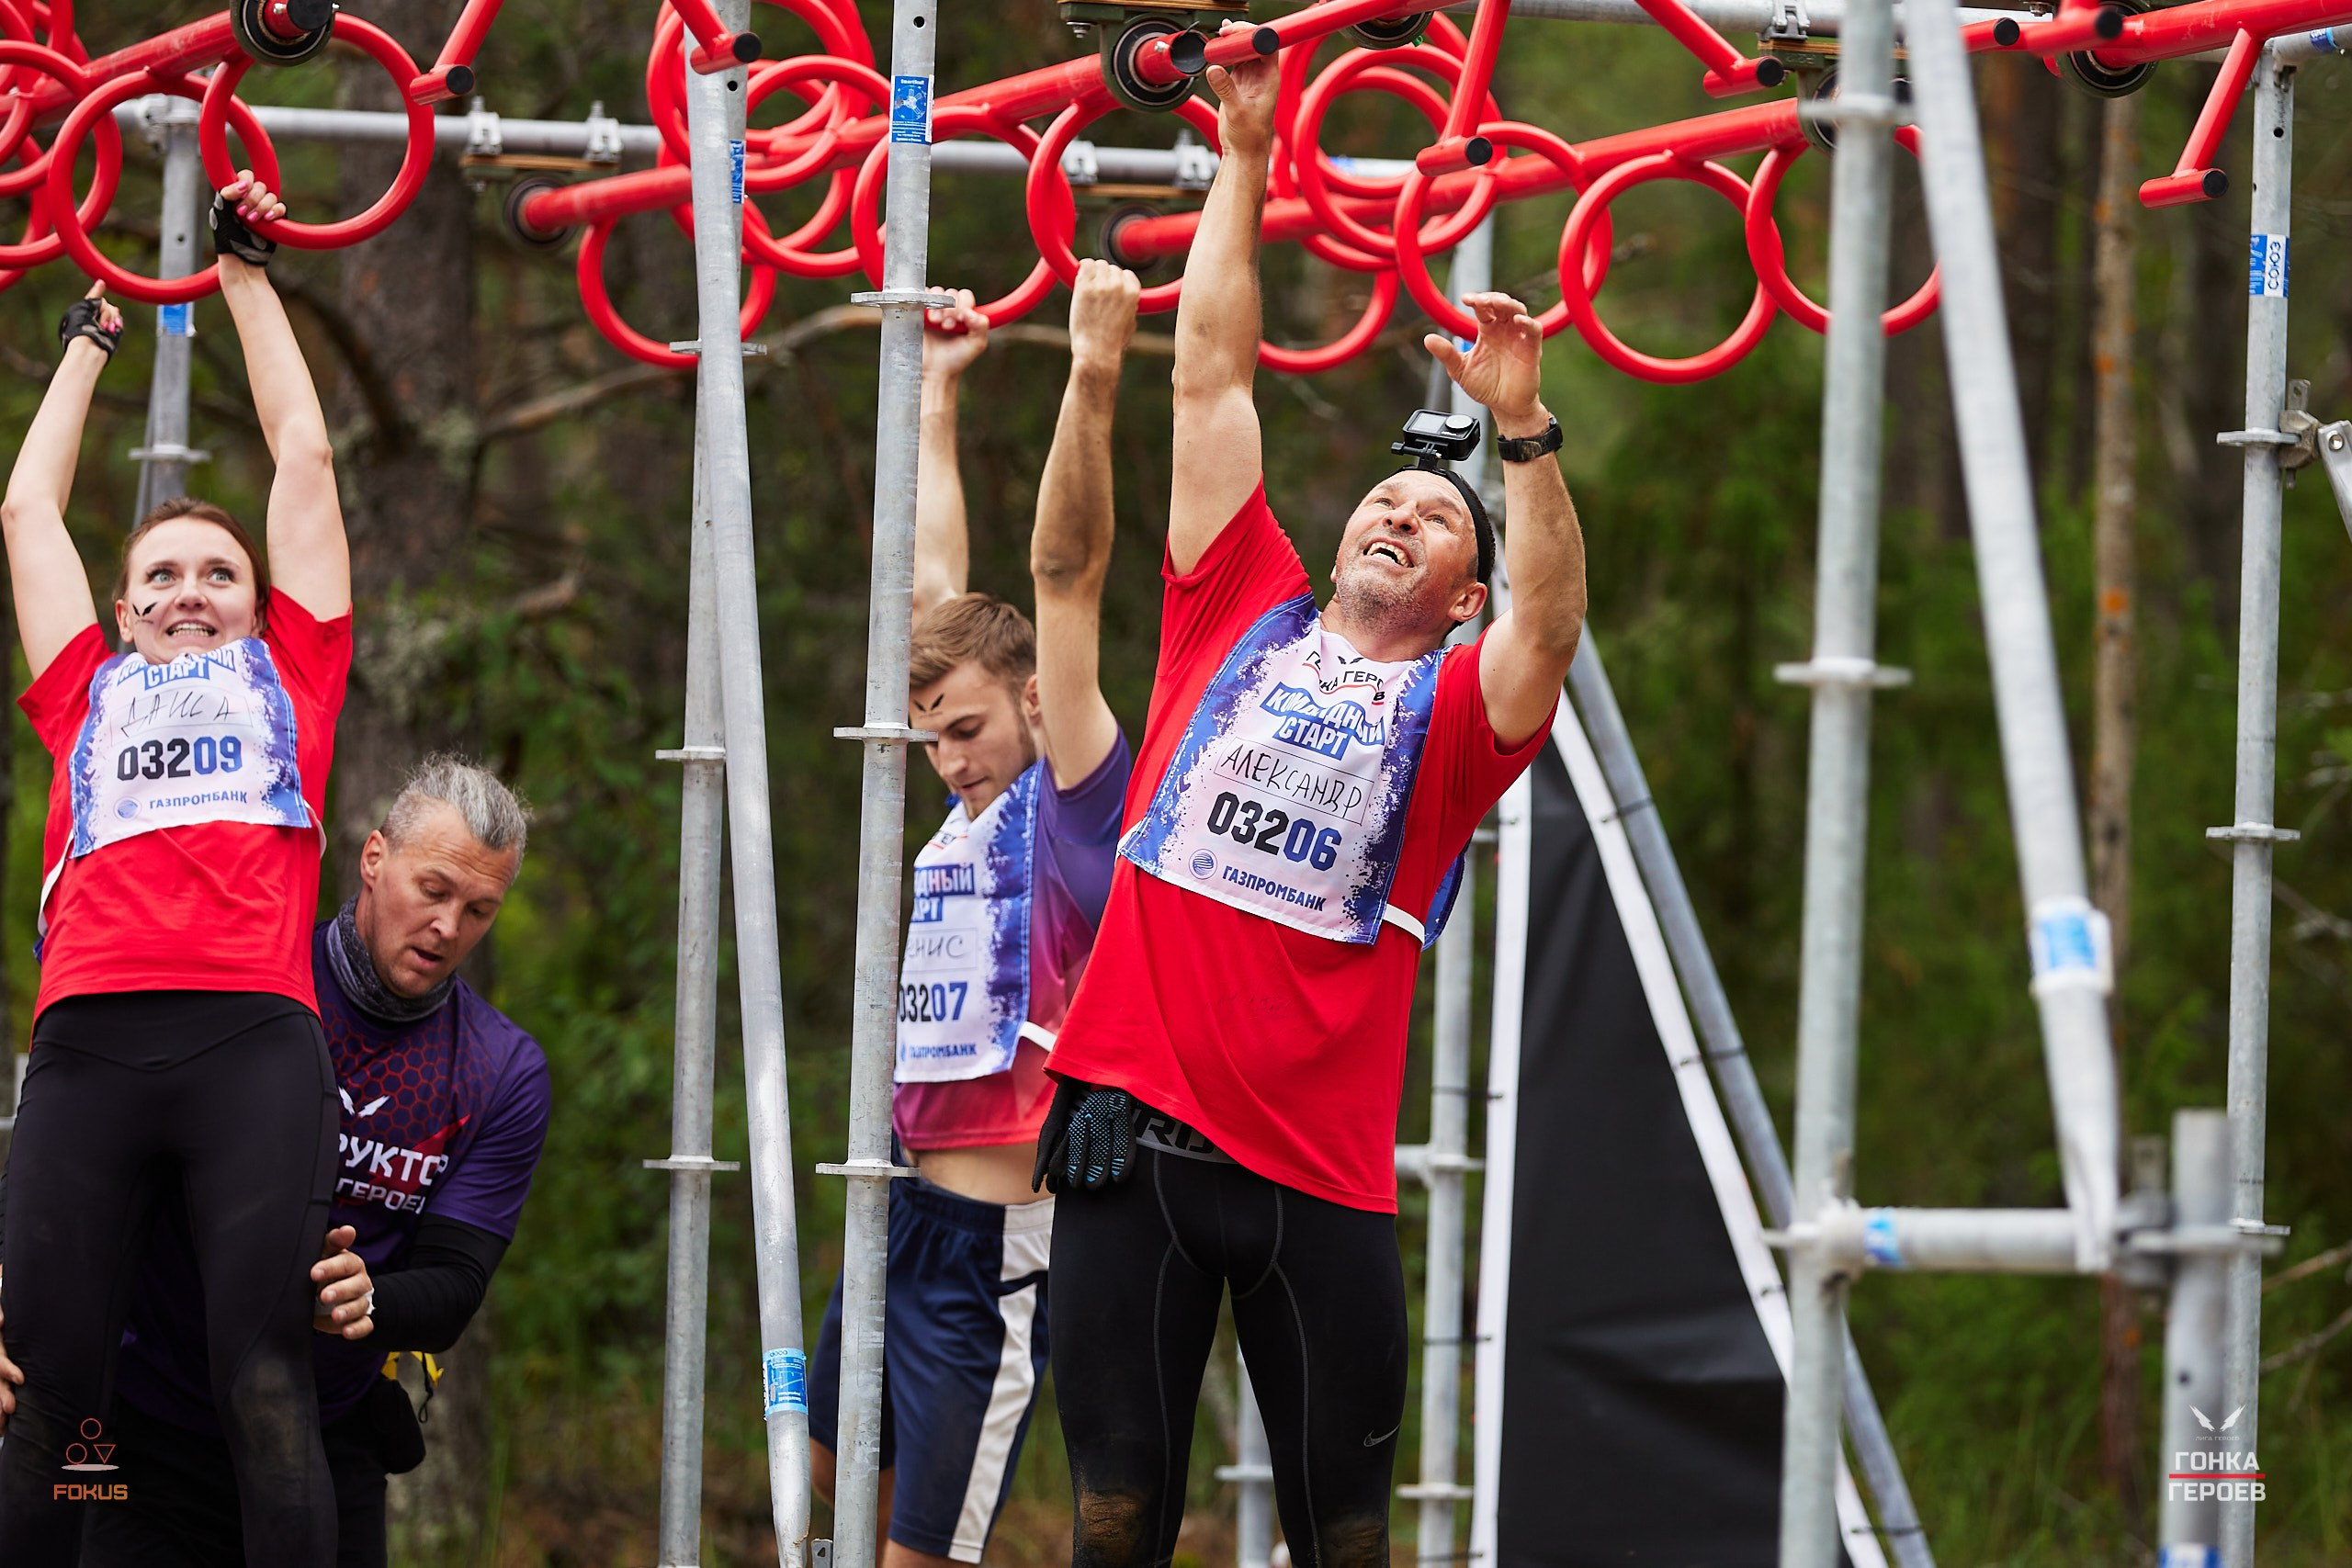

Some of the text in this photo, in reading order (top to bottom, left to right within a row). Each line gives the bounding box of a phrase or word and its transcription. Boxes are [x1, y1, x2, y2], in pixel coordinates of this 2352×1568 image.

[117, 735, 243, 782] 03209
[1278, 716, 1350, 756] СТАРТ
[149, 790, 248, 809] ГАЗПРОМБАНК
[1220, 743, 1363, 818] АЛЕКСАНДР
[1206, 791, 1342, 872] 03206
[1222, 865, 1328, 912] ГАЗПРОМБАНК
[899, 981, 968, 1022] 03207
